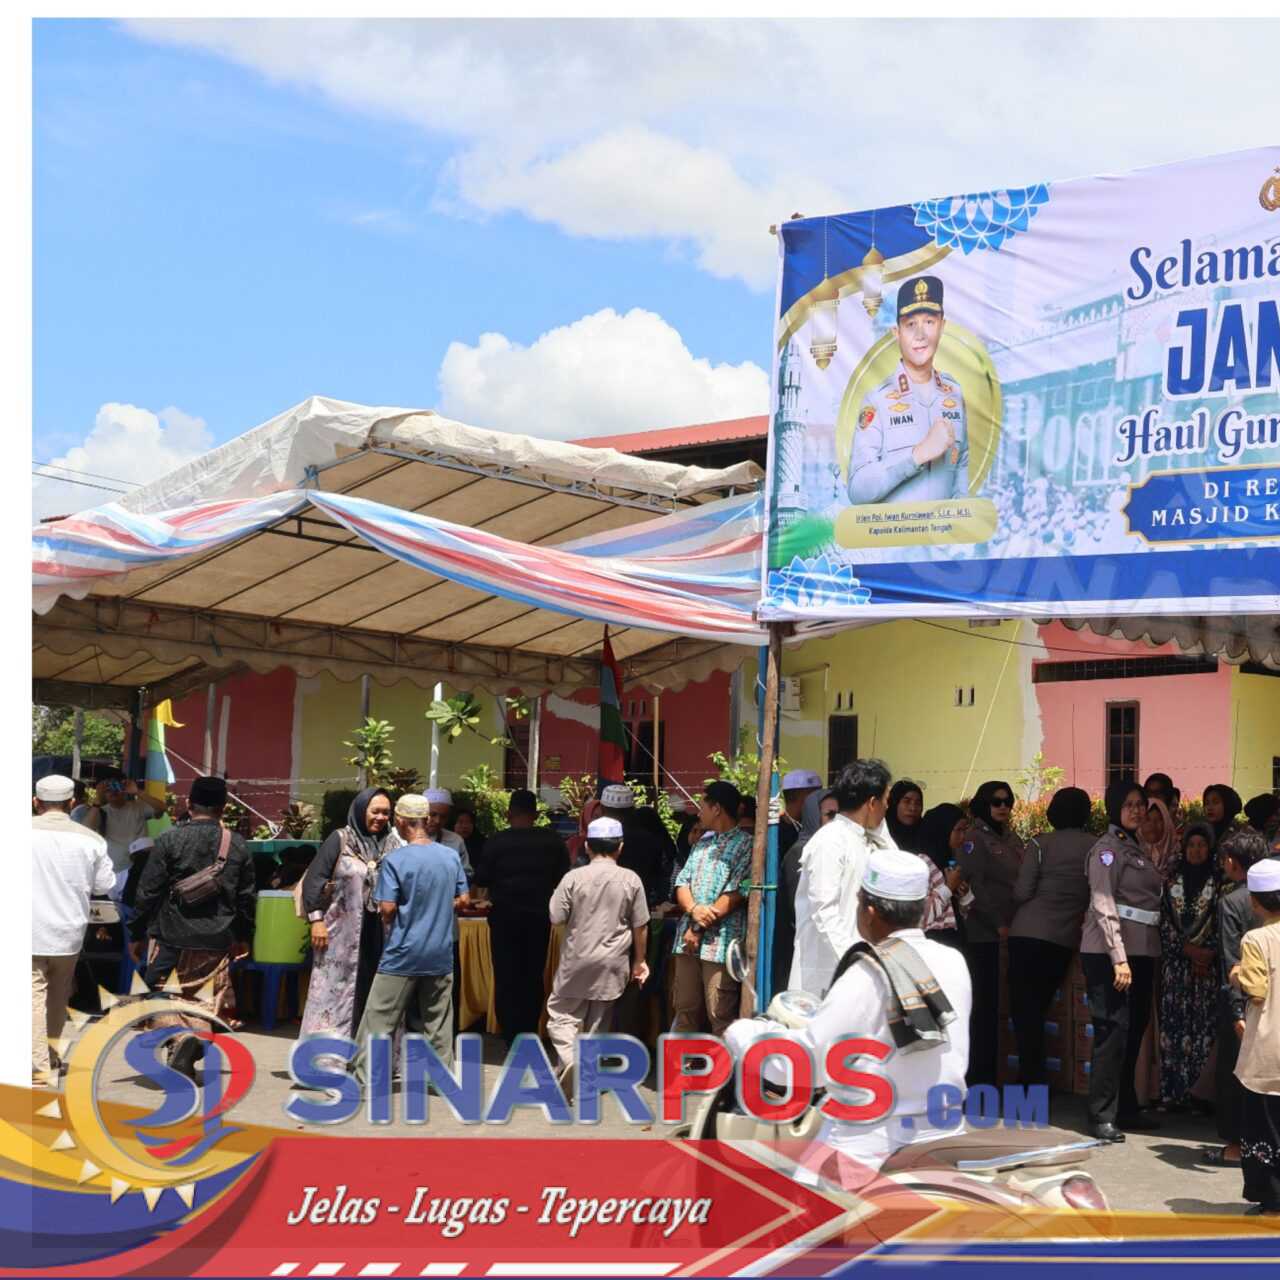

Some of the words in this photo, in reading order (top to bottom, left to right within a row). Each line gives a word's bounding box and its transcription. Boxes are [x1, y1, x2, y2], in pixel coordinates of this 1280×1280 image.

[889, 414, 914, 426] IWAN
[1116, 409, 1207, 463] Haul
[1203, 479, 1232, 501] DI
[1151, 505, 1250, 528] MASJID
[893, 525, 929, 535] Kalimantan
[930, 524, 953, 534] Tengah
